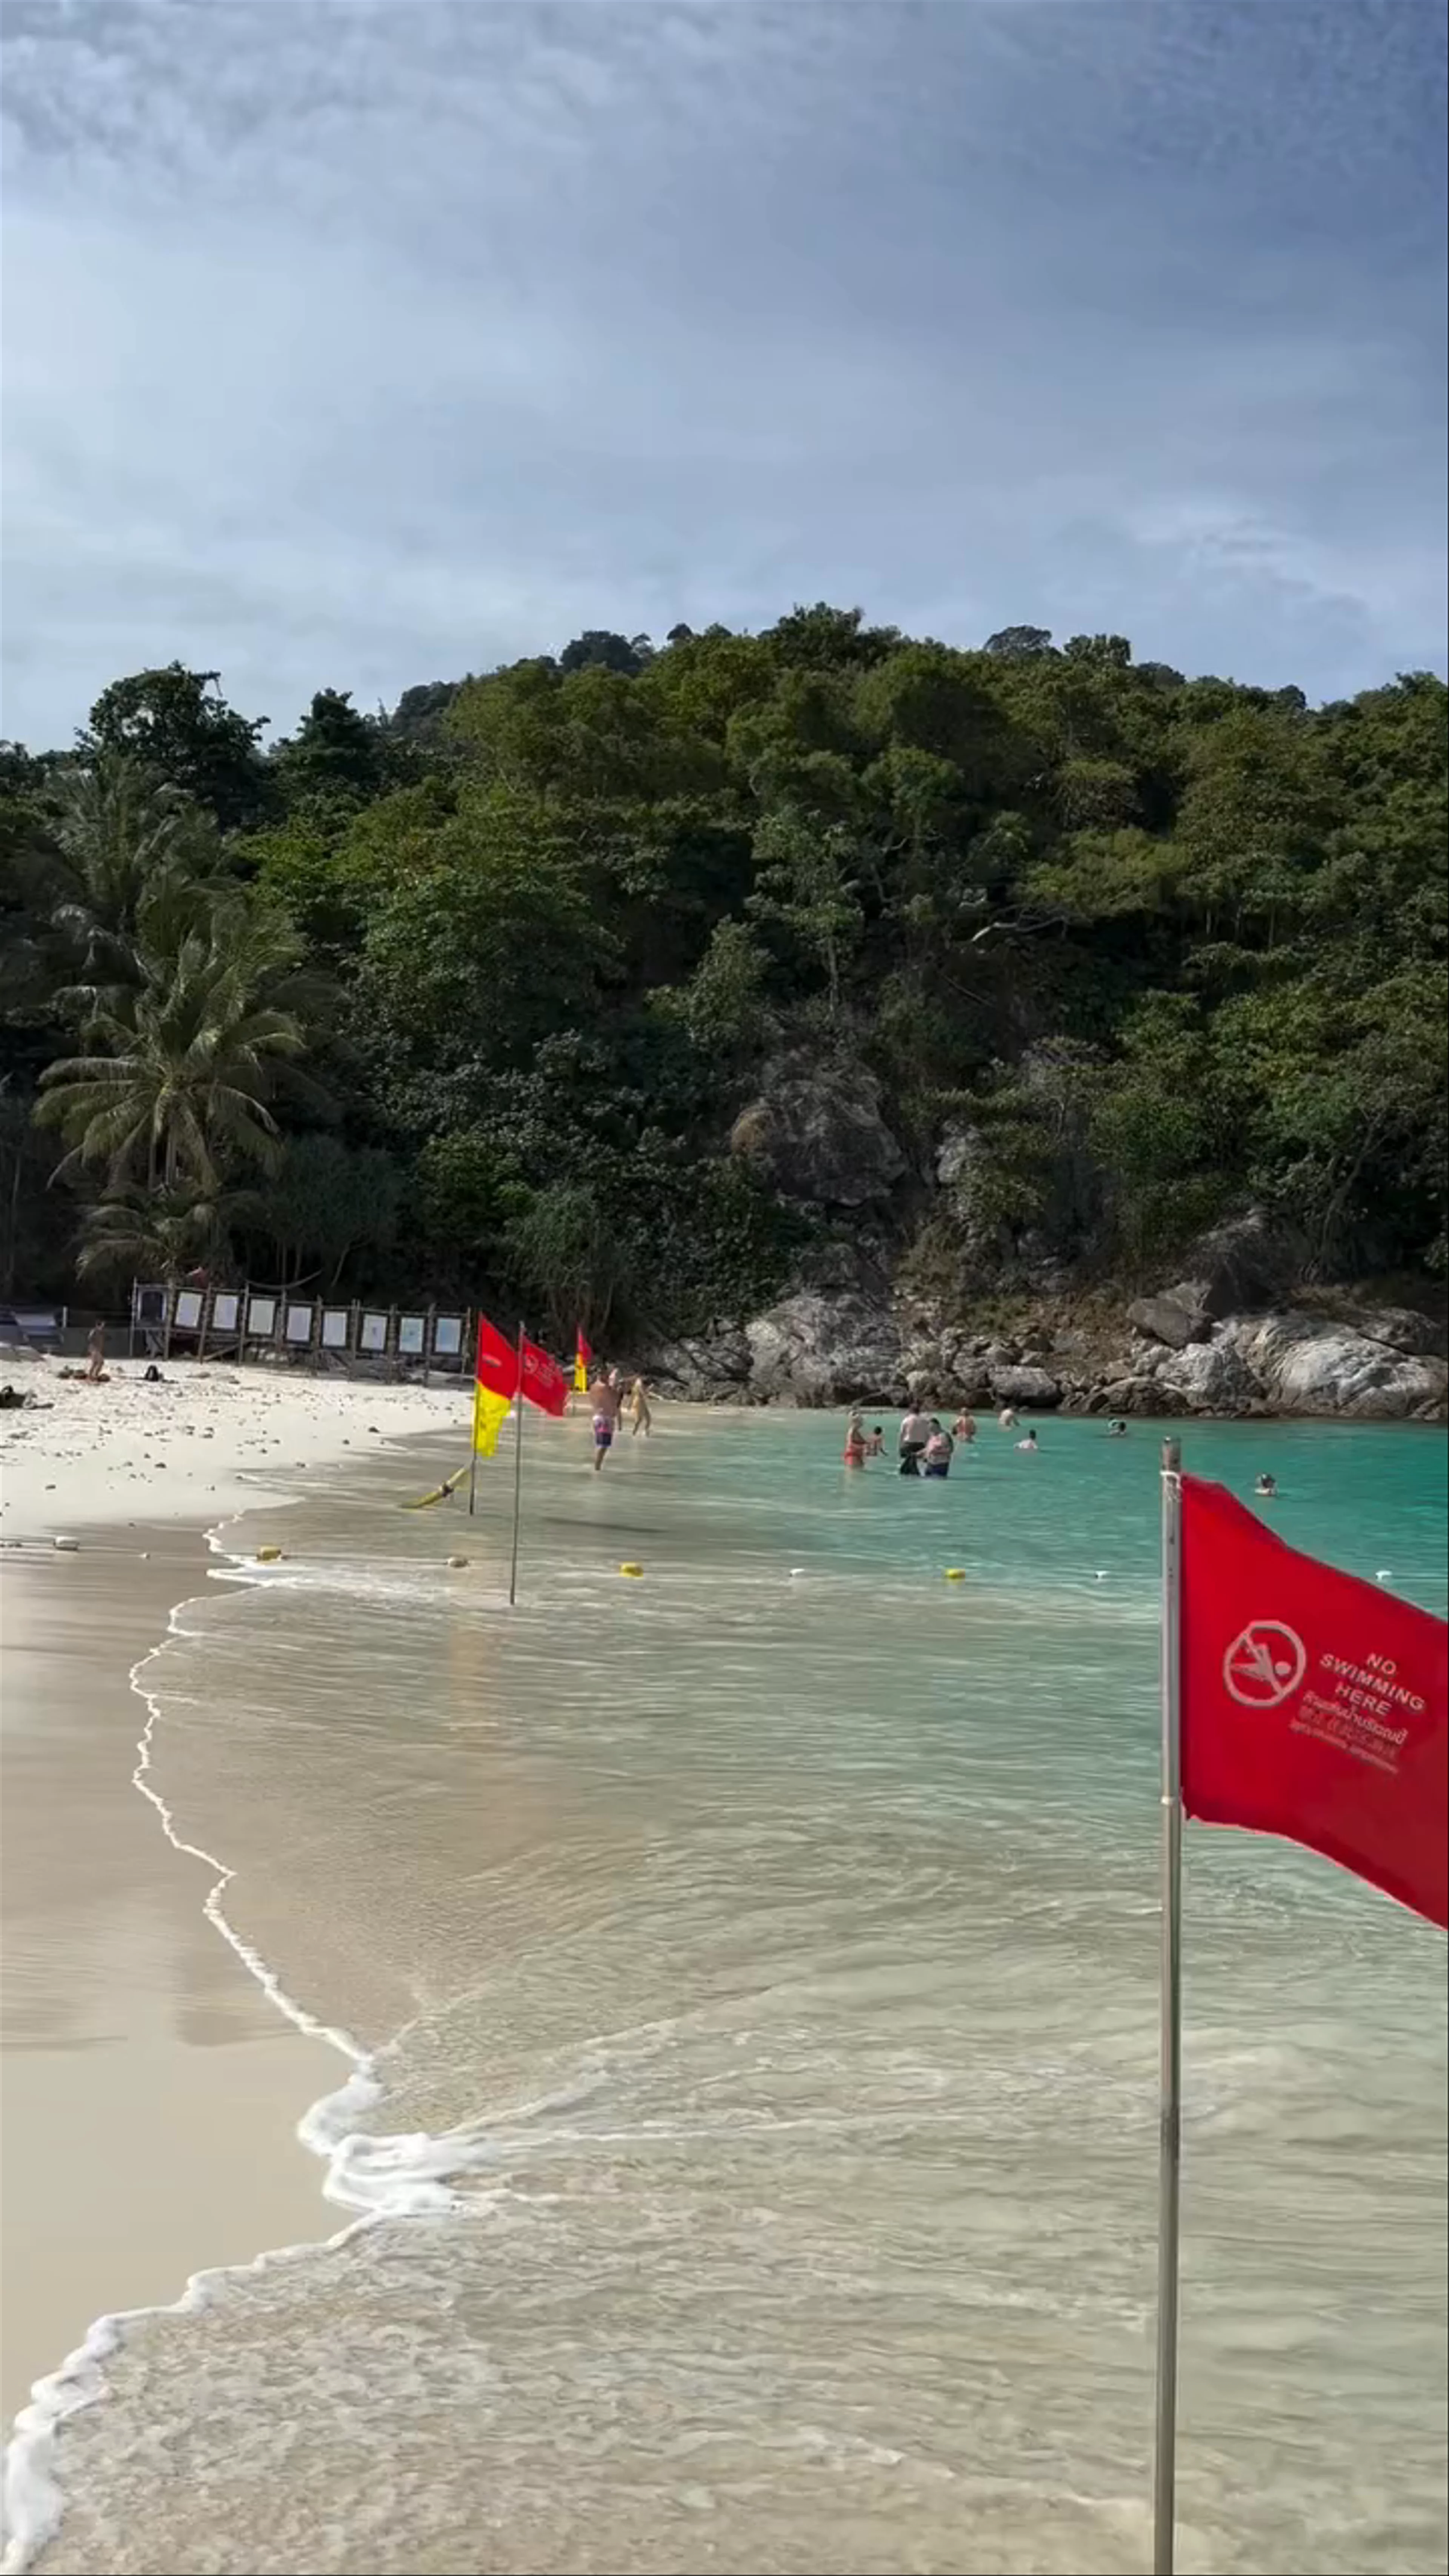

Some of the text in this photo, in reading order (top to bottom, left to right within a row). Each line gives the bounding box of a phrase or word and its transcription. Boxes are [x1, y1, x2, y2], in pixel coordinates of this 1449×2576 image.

[1367, 1652, 1397, 1675] NO
[1320, 1653, 1424, 1710] SWIMMING
[1335, 1681, 1392, 1716] HERE
